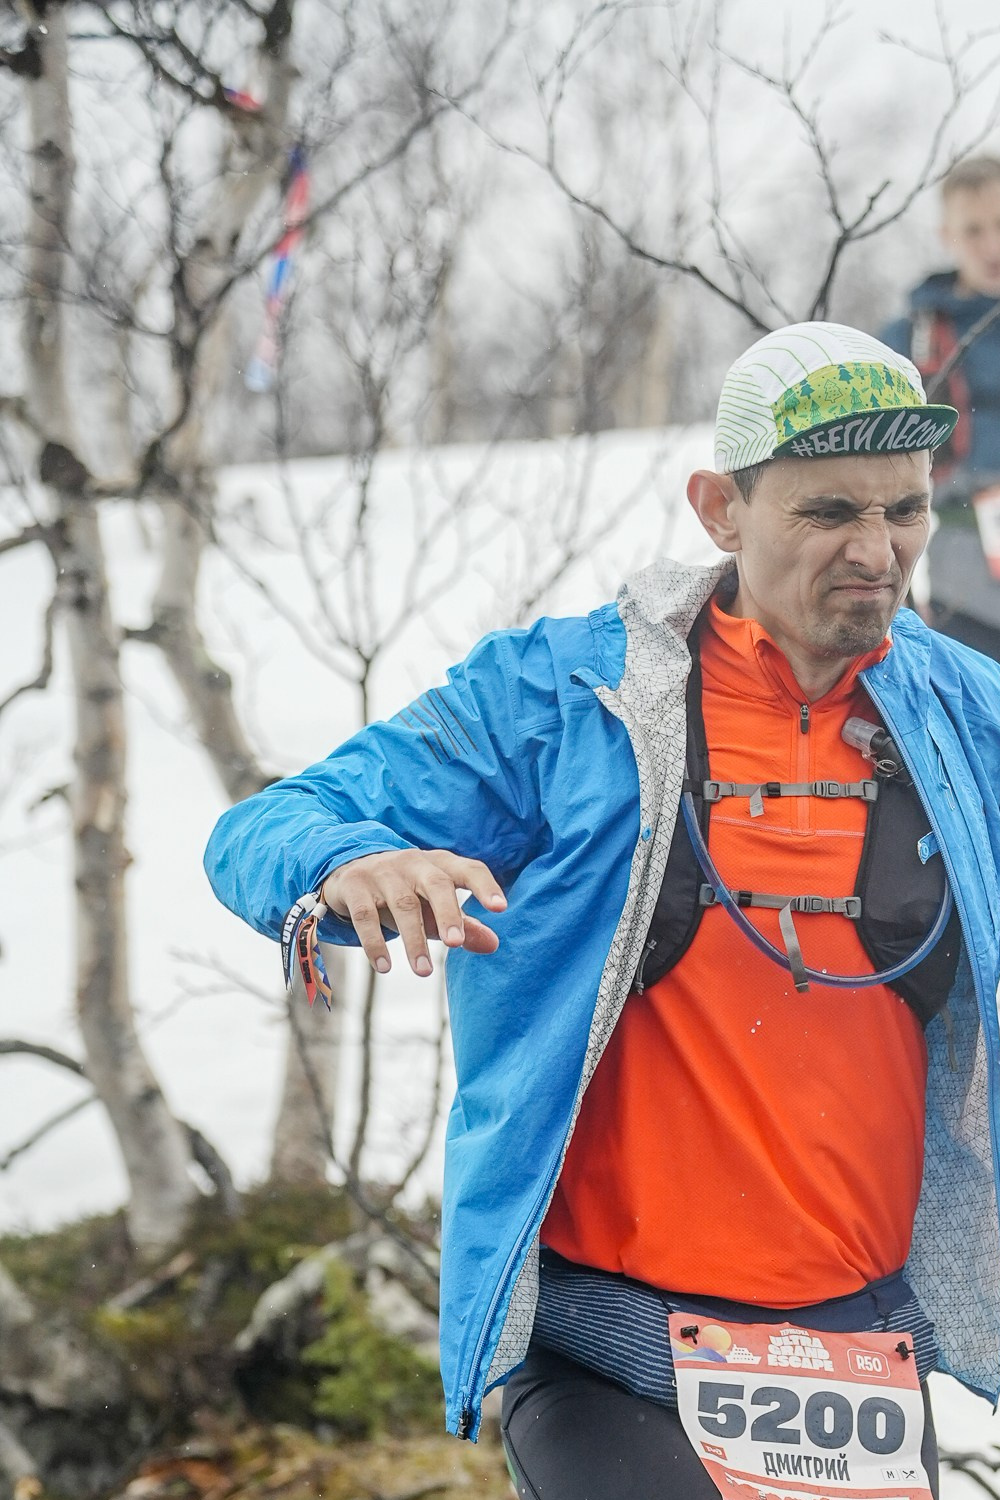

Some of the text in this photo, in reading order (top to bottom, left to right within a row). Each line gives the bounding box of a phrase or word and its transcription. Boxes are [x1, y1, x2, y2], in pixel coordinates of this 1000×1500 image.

[791, 410, 950, 458] #БЕГИ ЛЕСОМ
[282, 903, 304, 943] ULTR
[768, 1344, 830, 1360] GRAND
[769, 1335, 824, 1349] ULTRA
[767, 1354, 834, 1372] ESCAPE
[856, 1354, 882, 1373] R50
[697, 1381, 906, 1455] 5200
[762, 1451, 851, 1482] ДМИТРИЙ
